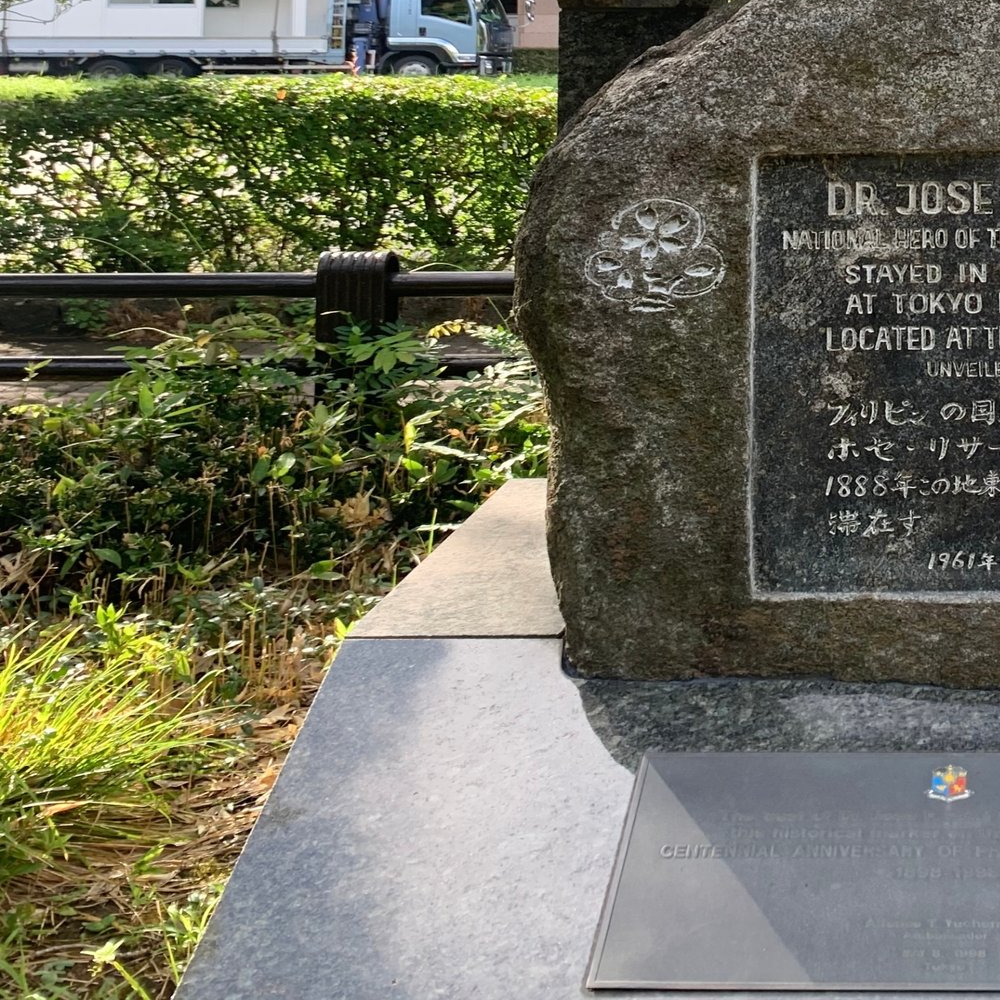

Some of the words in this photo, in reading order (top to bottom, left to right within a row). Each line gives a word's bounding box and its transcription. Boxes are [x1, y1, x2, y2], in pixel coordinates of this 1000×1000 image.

[827, 180, 888, 217] DR.
[896, 180, 993, 216] JOSE
[782, 229, 889, 251] NATIONAL
[894, 229, 948, 250] HERO
[954, 229, 981, 249] OF
[845, 263, 942, 285] STAYED
[958, 263, 988, 284] IN
[845, 293, 877, 316] AT
[891, 293, 983, 315] TOKYO
[825, 326, 936, 352] LOCATED
[945, 326, 979, 351] AT
